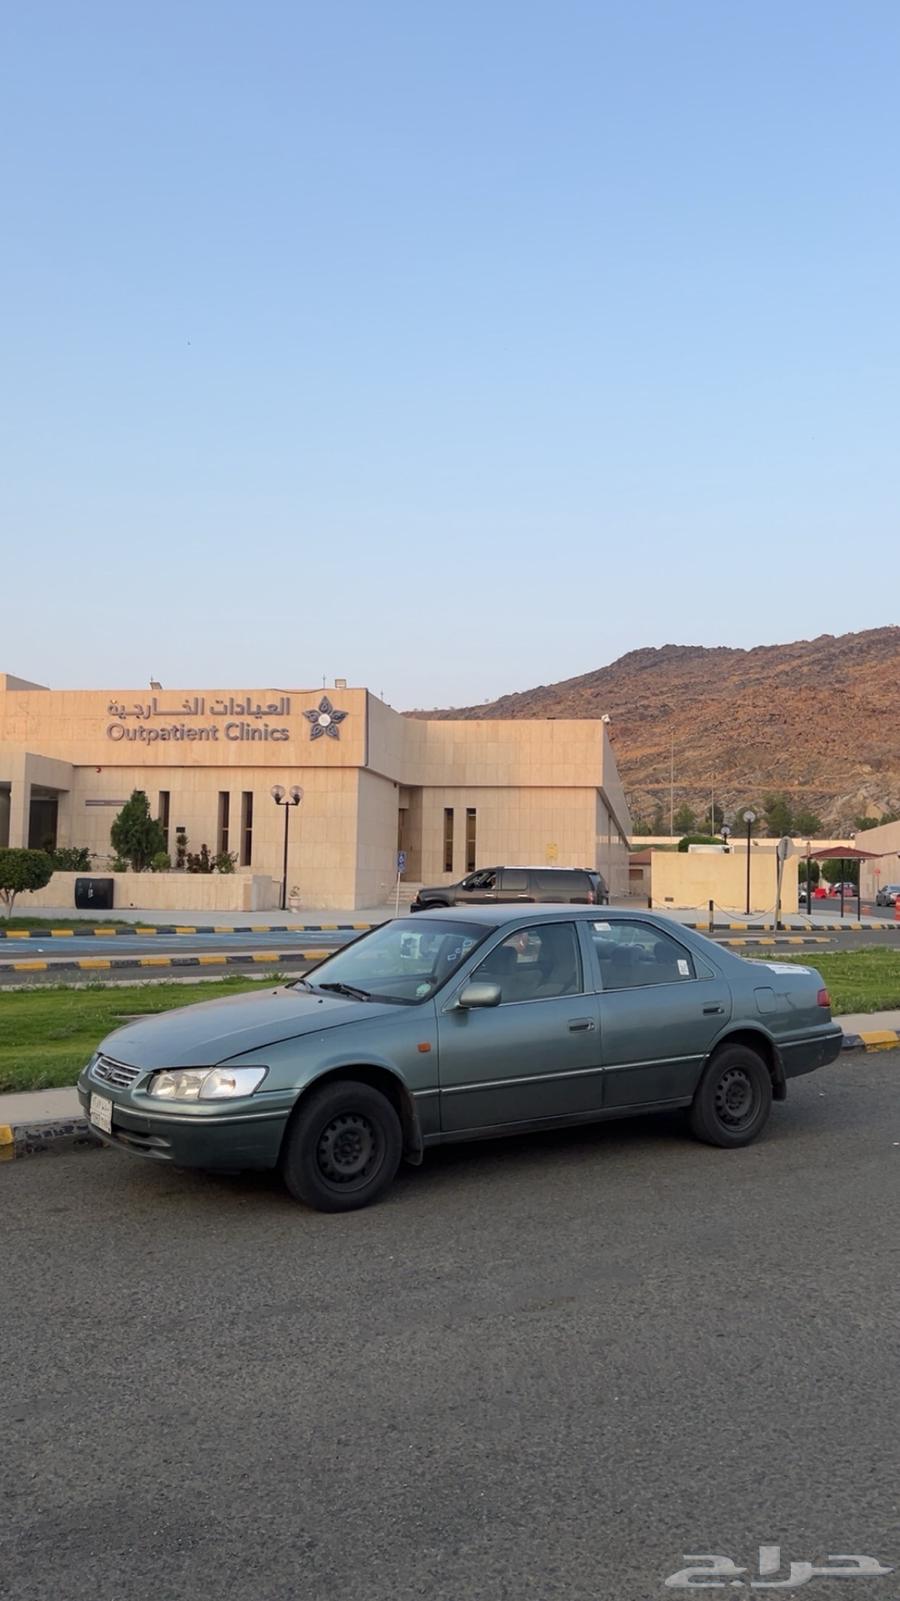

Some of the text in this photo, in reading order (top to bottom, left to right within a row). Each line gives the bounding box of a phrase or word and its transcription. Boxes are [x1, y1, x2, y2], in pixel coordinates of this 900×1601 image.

[107, 697, 291, 719] العيادات الخارجية
[107, 722, 290, 745] Outpatient Clinics
